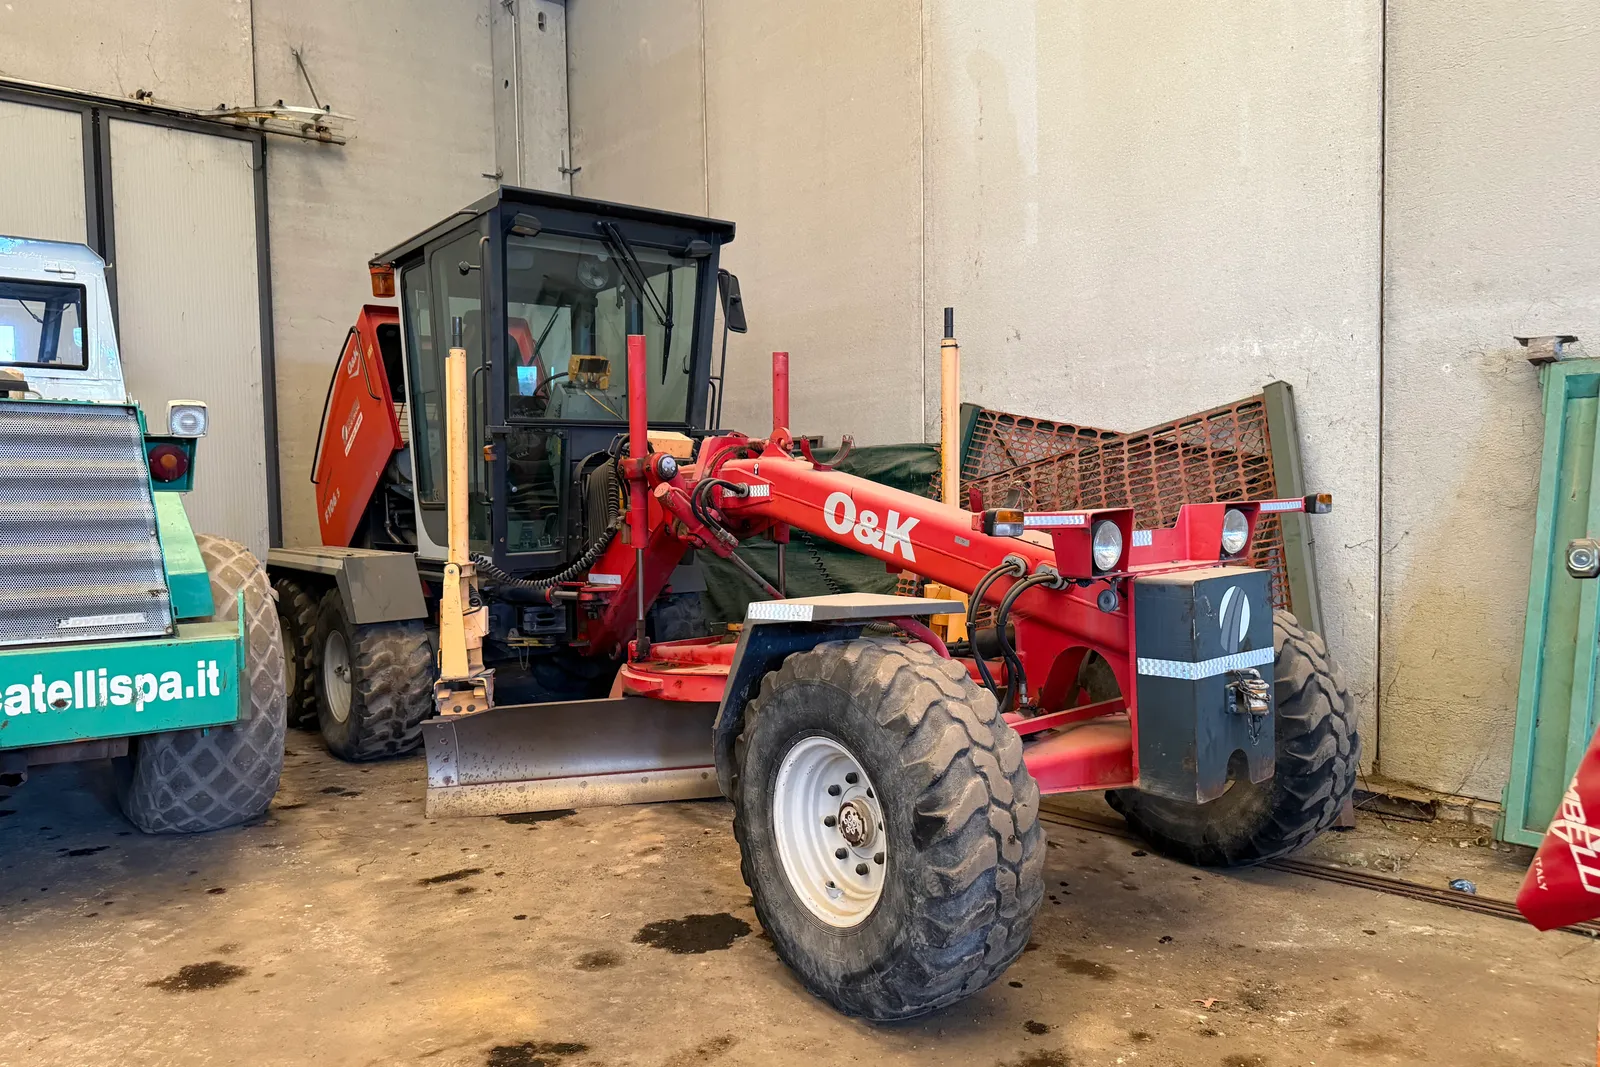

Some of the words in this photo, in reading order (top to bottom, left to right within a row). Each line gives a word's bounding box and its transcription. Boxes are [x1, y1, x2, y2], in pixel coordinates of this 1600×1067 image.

[823, 491, 921, 563] O&K
[0, 660, 220, 716] atellispa.it
[1535, 856, 1549, 892] ITALY
